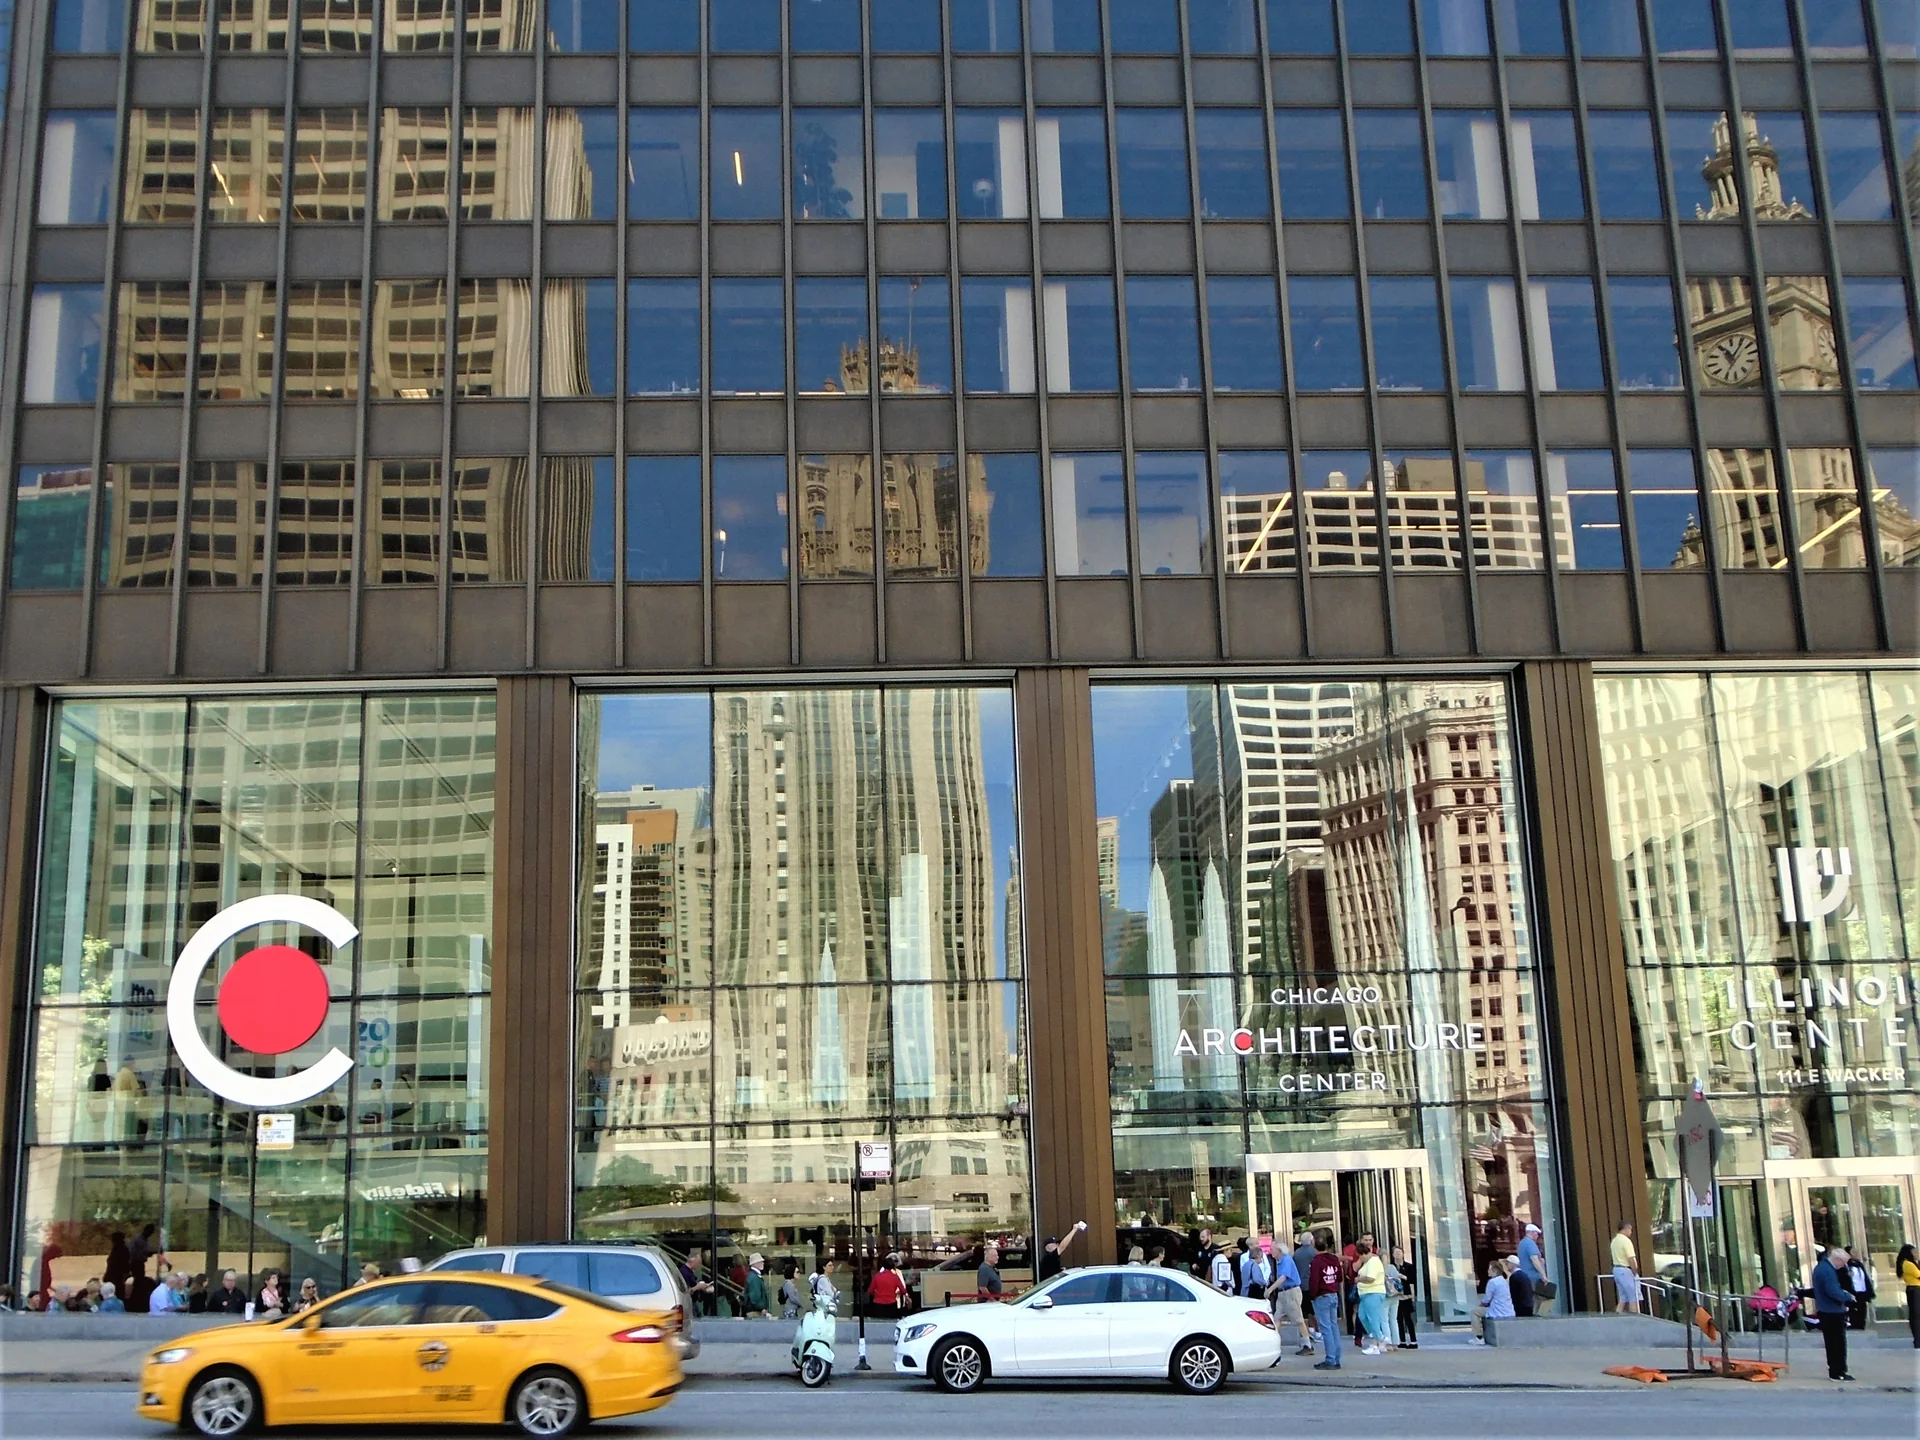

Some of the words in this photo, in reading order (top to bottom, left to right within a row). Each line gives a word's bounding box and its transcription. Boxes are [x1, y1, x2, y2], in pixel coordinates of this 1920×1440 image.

[1270, 986, 1380, 1005] CHICAGO
[1173, 1024, 1485, 1056] ARCHITECTURE
[1730, 1018, 1908, 1050] CENTE
[1279, 1072, 1388, 1093] CENTER
[1777, 1069, 1802, 1084] 111
[1809, 1069, 1820, 1083] E
[1826, 1067, 1906, 1083] WACKER
